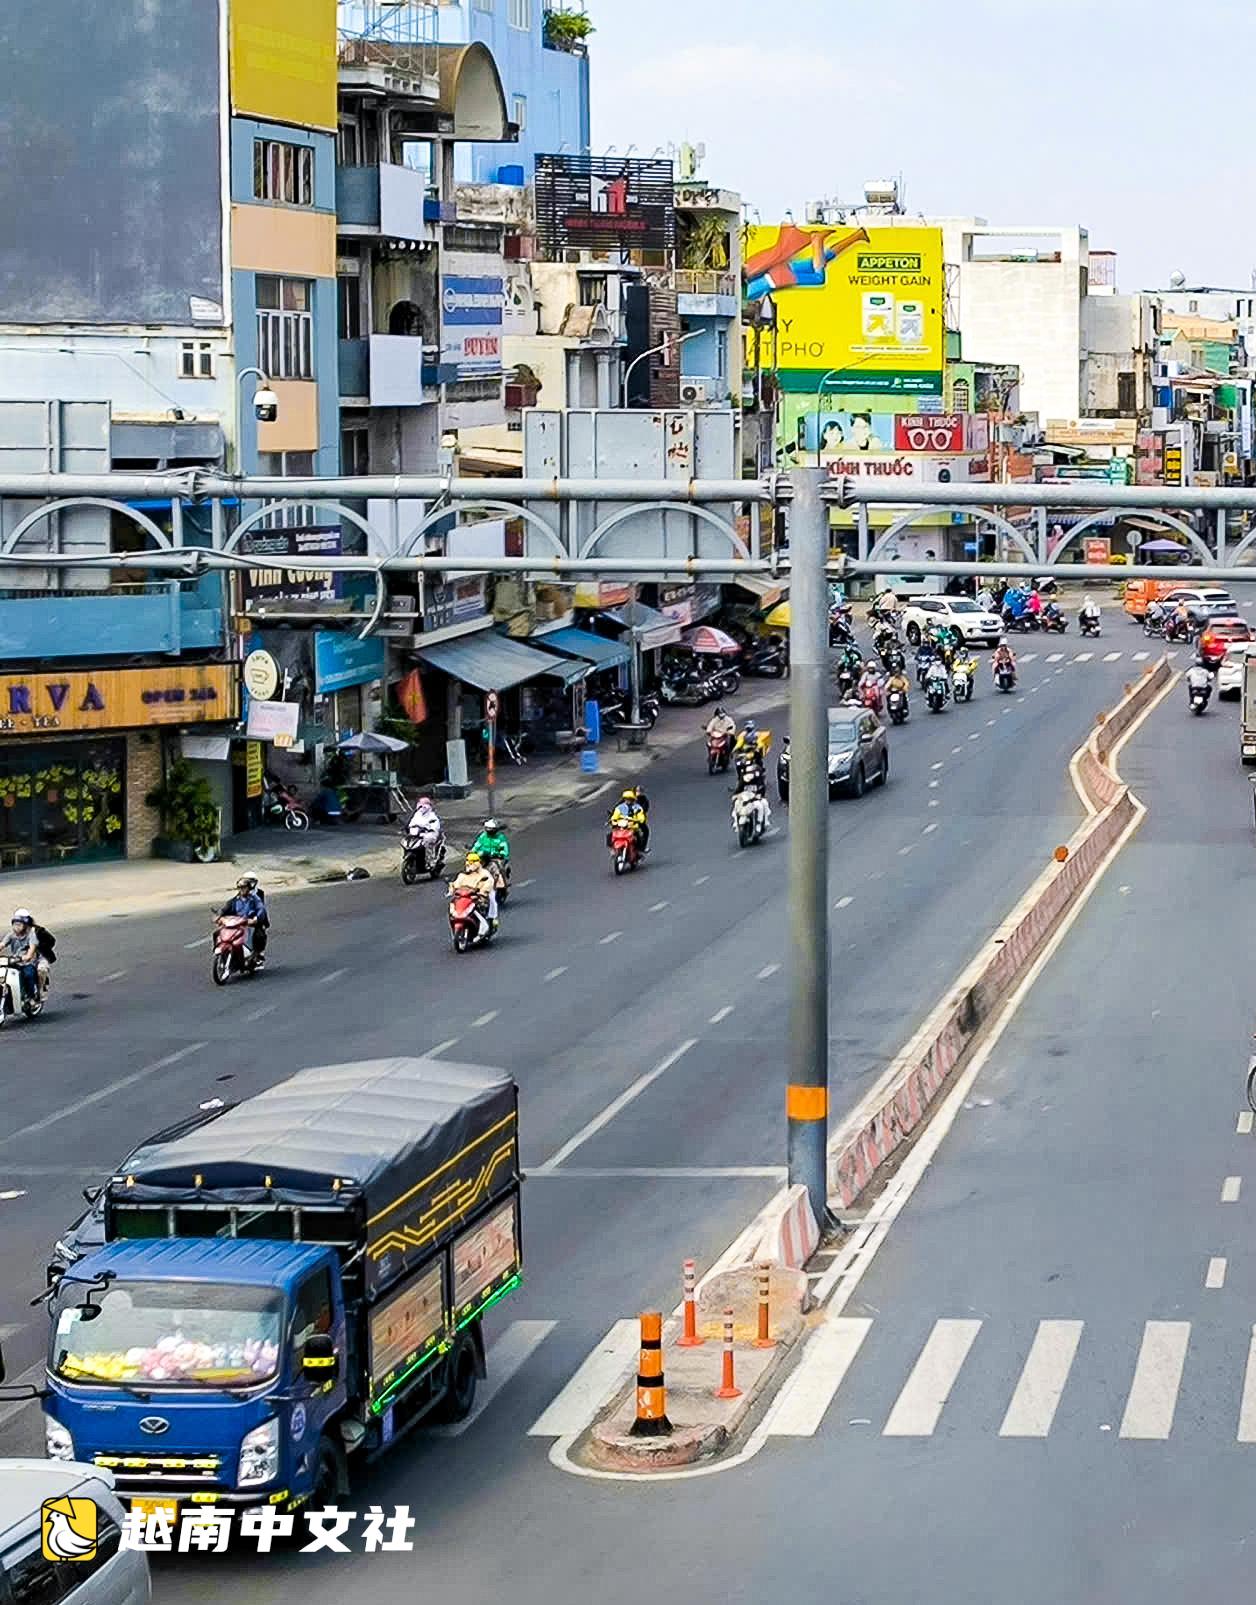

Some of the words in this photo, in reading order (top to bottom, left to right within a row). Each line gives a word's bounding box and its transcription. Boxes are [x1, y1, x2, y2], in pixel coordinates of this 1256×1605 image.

[861, 257, 919, 268] APPETON
[848, 275, 898, 286] WEIGHT
[900, 276, 931, 286] GAIN
